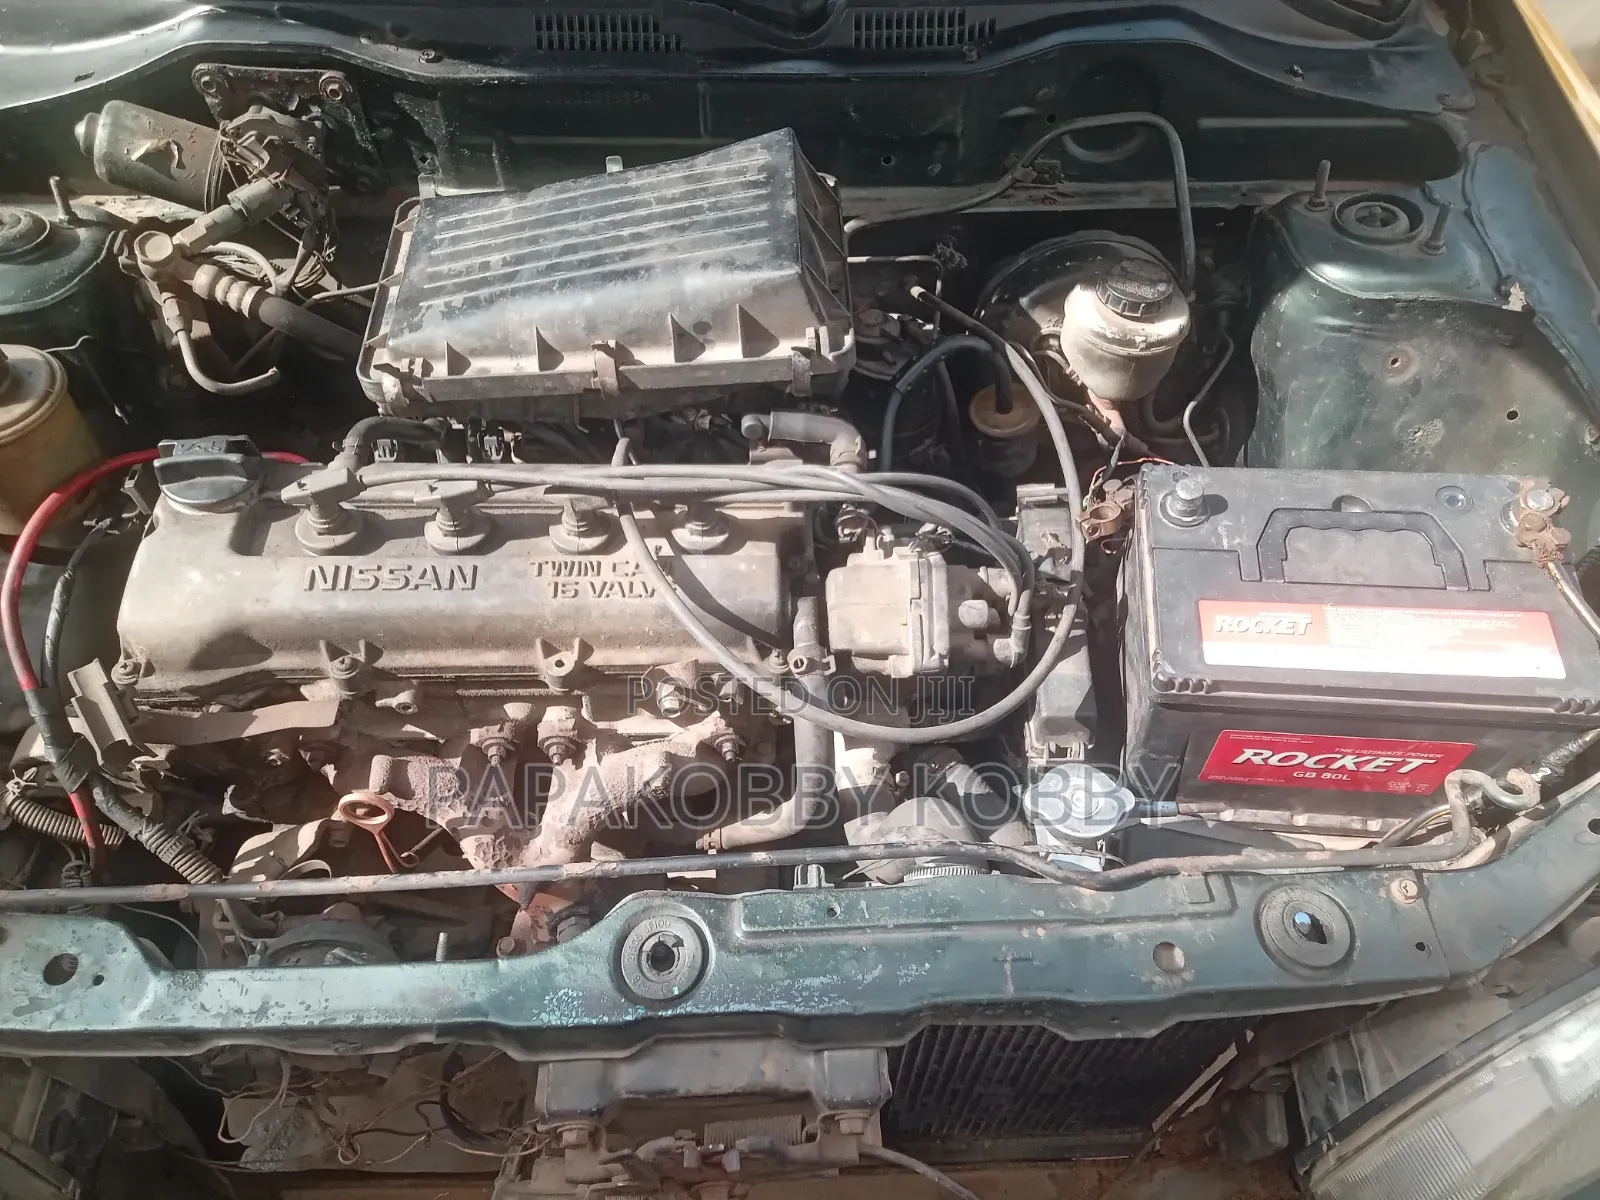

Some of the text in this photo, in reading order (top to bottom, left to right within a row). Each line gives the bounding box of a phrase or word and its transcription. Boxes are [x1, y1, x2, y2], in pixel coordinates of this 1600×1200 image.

[304, 563, 479, 592] NISSAN
[530, 559, 645, 578] TWIN CA
[588, 580, 656, 599] VALV
[1215, 613, 1313, 636] ROCKET
[1231, 748, 1438, 775] ROCKET
[1292, 770, 1318, 779] GB
